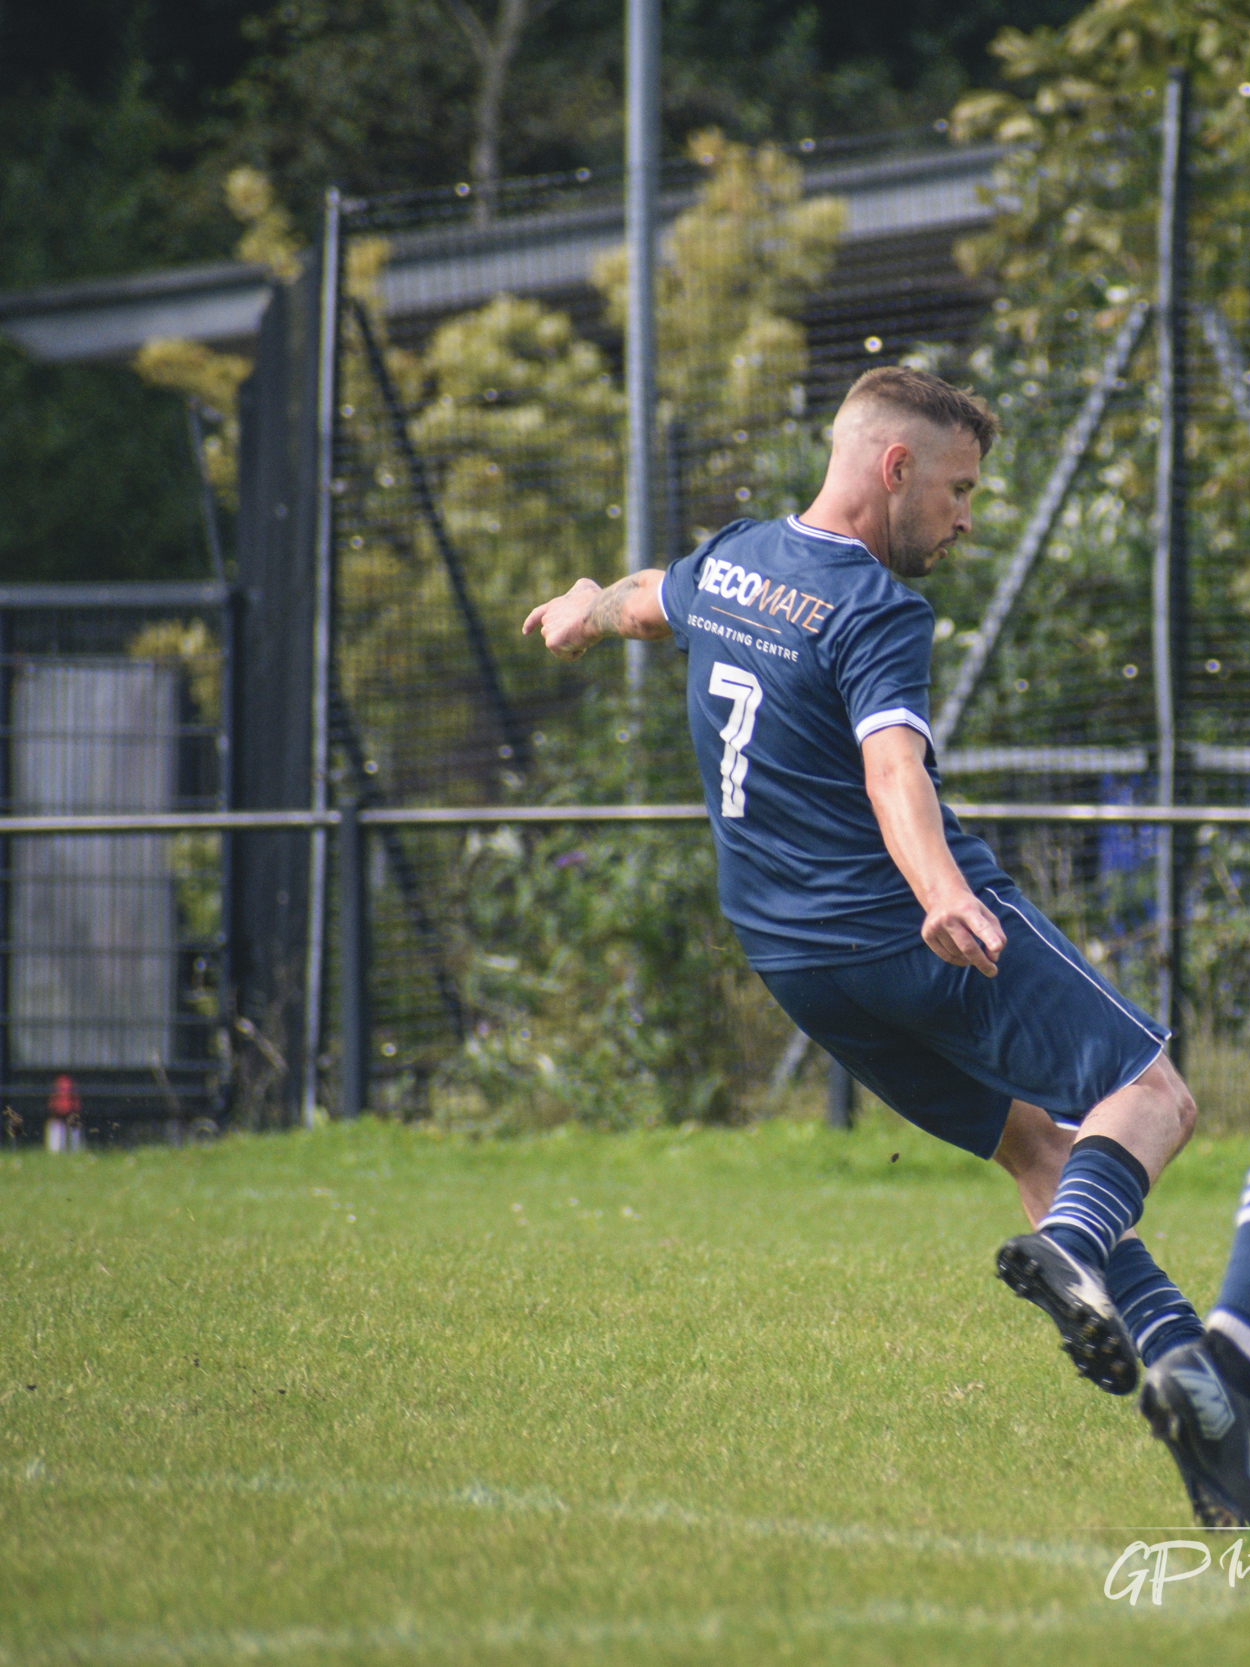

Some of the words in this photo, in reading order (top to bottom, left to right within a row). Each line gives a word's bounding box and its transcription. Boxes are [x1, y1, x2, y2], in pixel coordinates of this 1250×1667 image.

[698, 557, 835, 634] DECOMATE
[687, 613, 753, 646] DECORATING
[755, 638, 799, 662] CENTRE
[708, 661, 763, 818] 7
